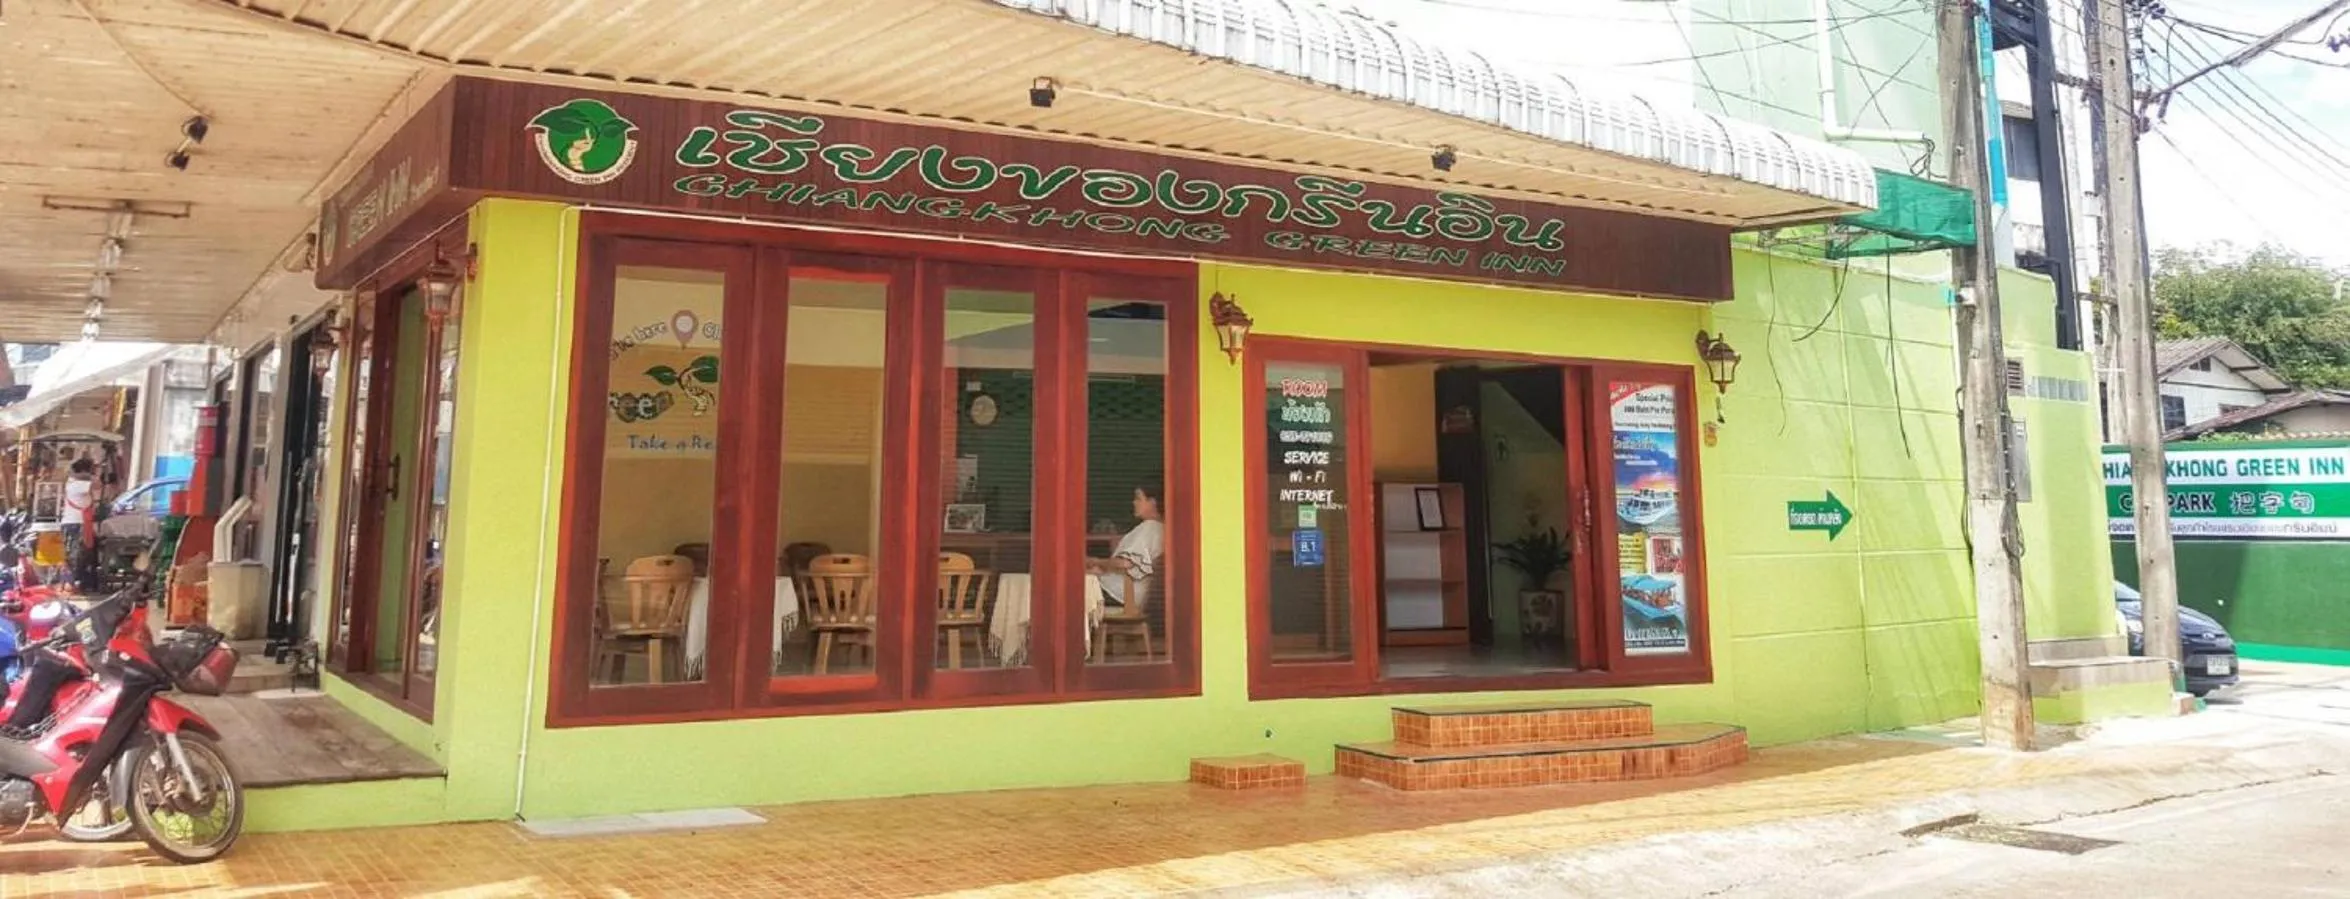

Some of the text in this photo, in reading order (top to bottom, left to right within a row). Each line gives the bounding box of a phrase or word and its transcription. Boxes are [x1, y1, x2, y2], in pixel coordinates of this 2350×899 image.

[675, 110, 1565, 251] เชียงของกรีนอิน
[673, 173, 1567, 277] CHIANGKHONG GREEN INN
[1281, 379, 1328, 398] ROOM
[1284, 450, 1330, 465] SERVICE
[2236, 457, 2300, 477] GREEN
[2309, 456, 2345, 475] INN
[1280, 489, 1334, 505] INTERNET
